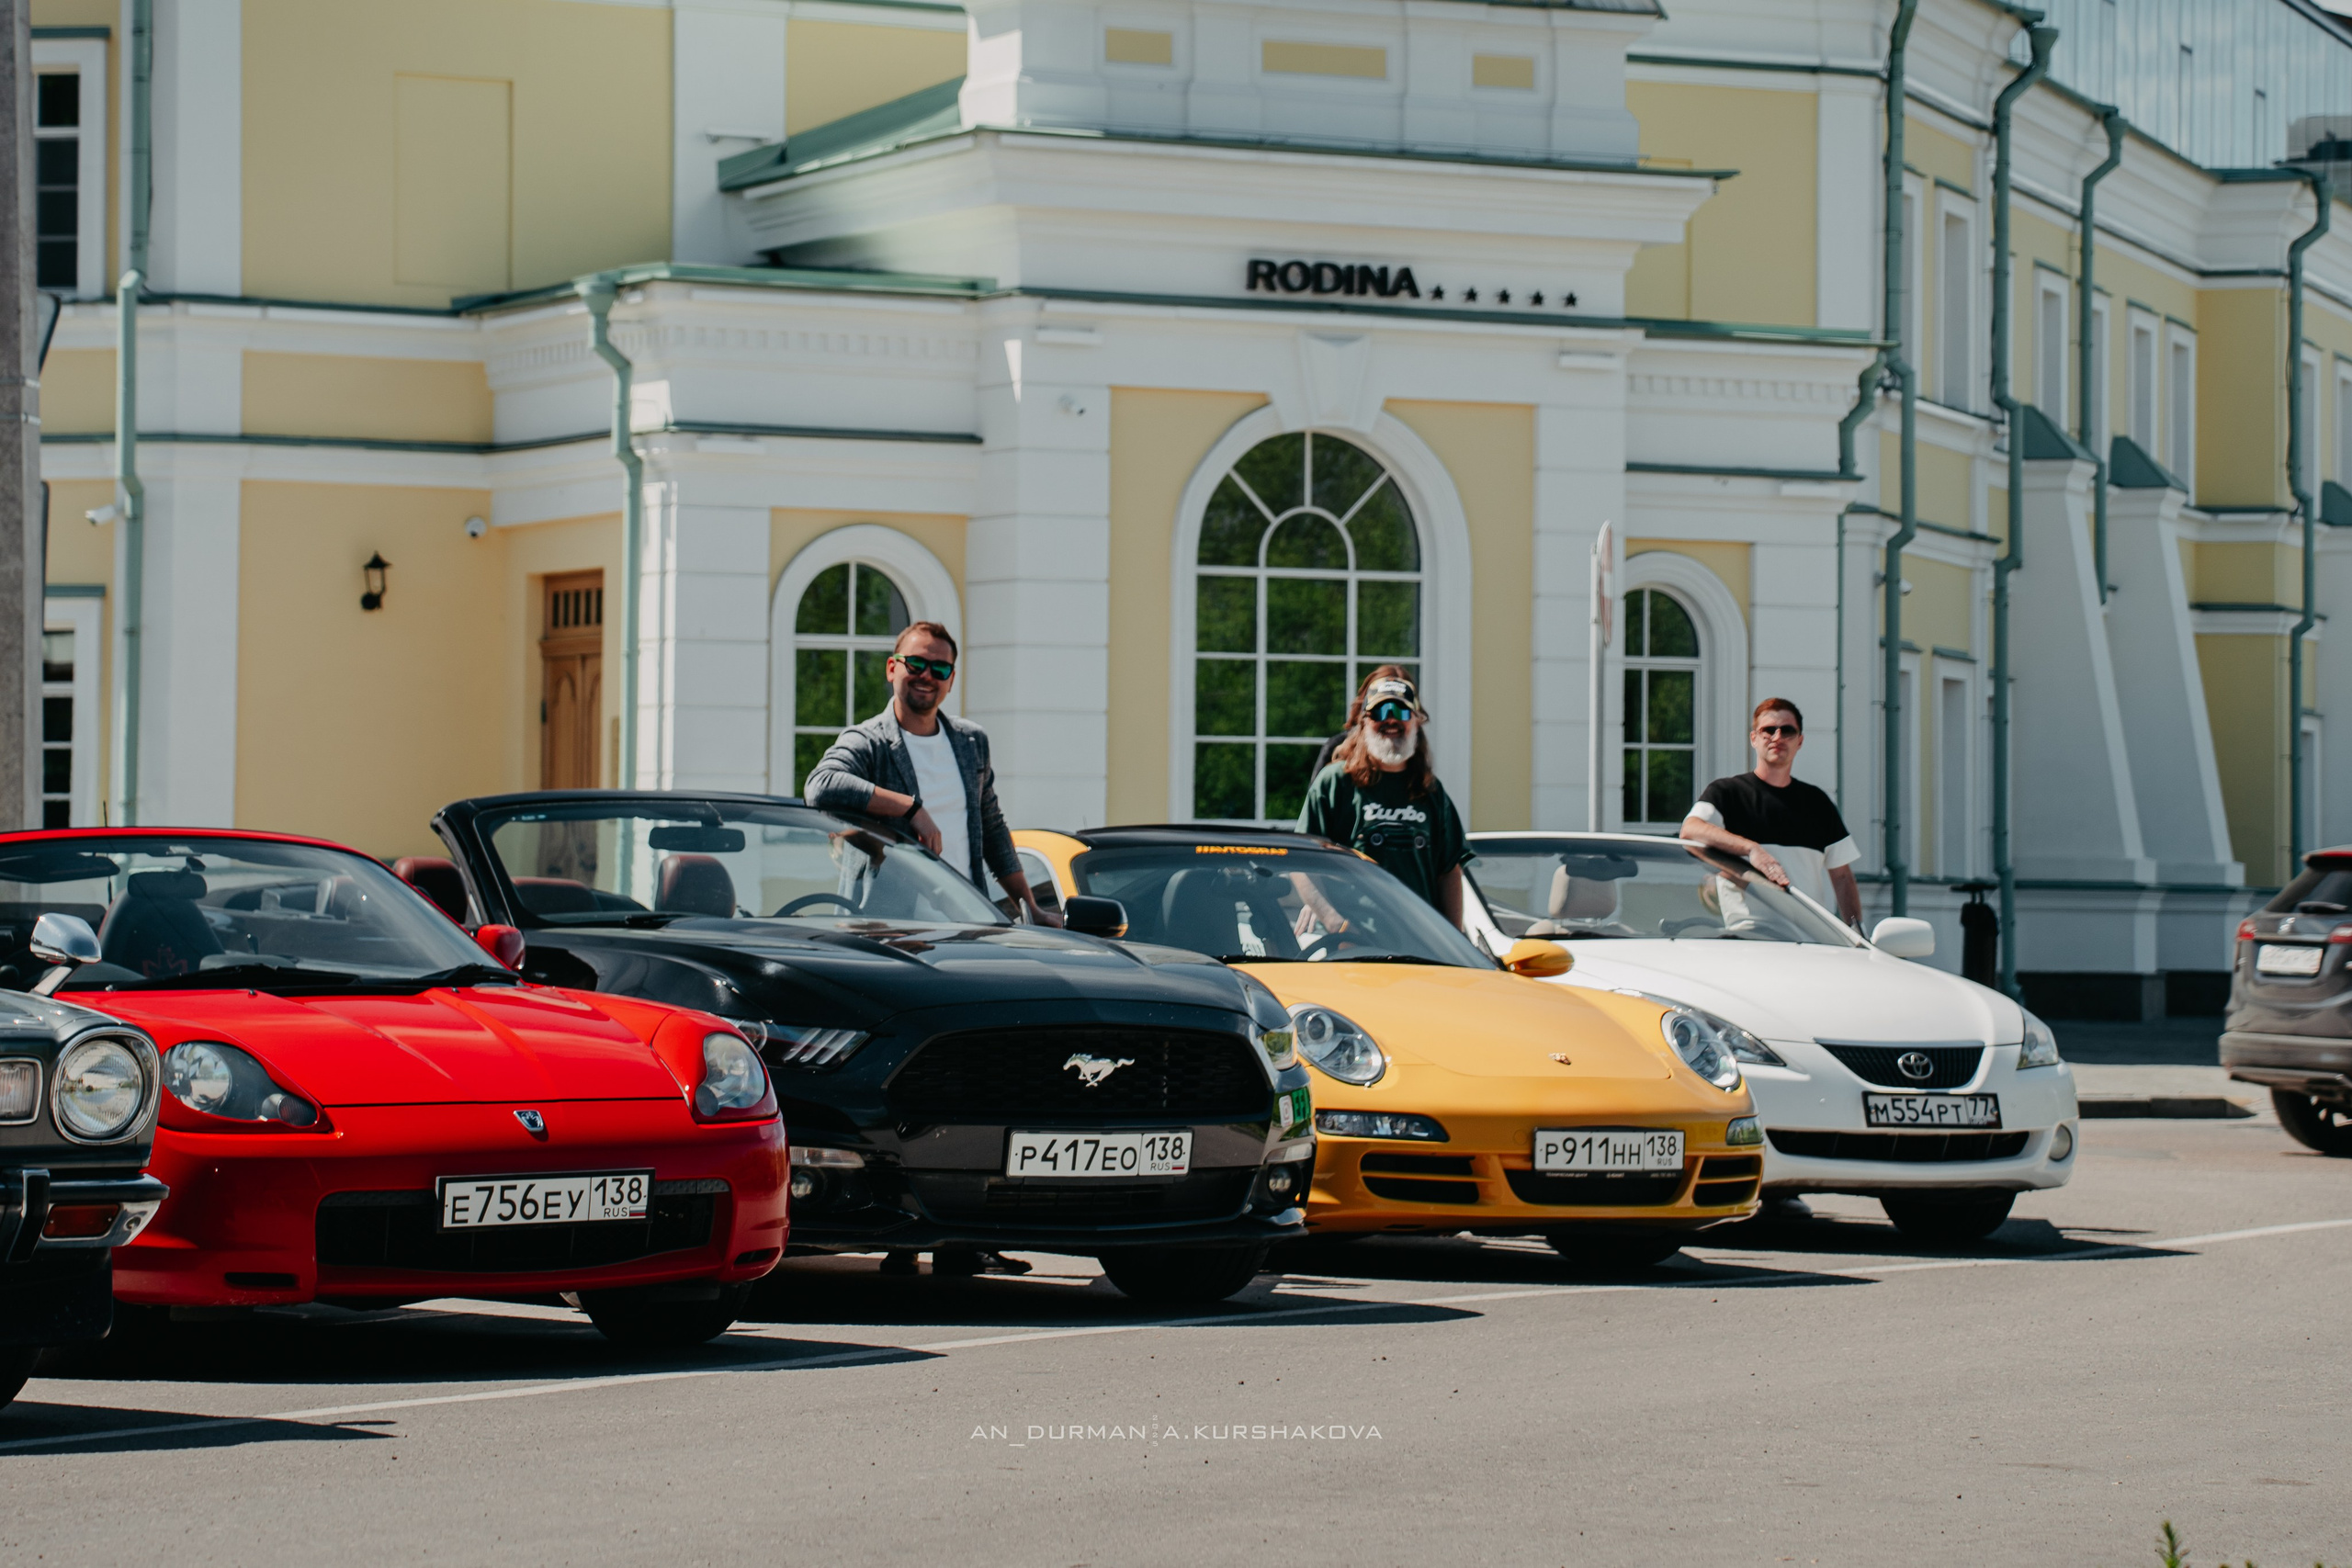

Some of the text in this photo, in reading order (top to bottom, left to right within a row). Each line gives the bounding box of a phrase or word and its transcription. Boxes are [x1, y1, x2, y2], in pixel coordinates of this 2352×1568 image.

[1246, 259, 1420, 299] RODINA
[1968, 1097, 1989, 1117] 77
[1145, 1135, 1184, 1161] 138
[1646, 1135, 1677, 1156] 138
[1149, 1162, 1170, 1171] RUS
[594, 1177, 642, 1206] 138
[603, 1206, 628, 1218] RUS
